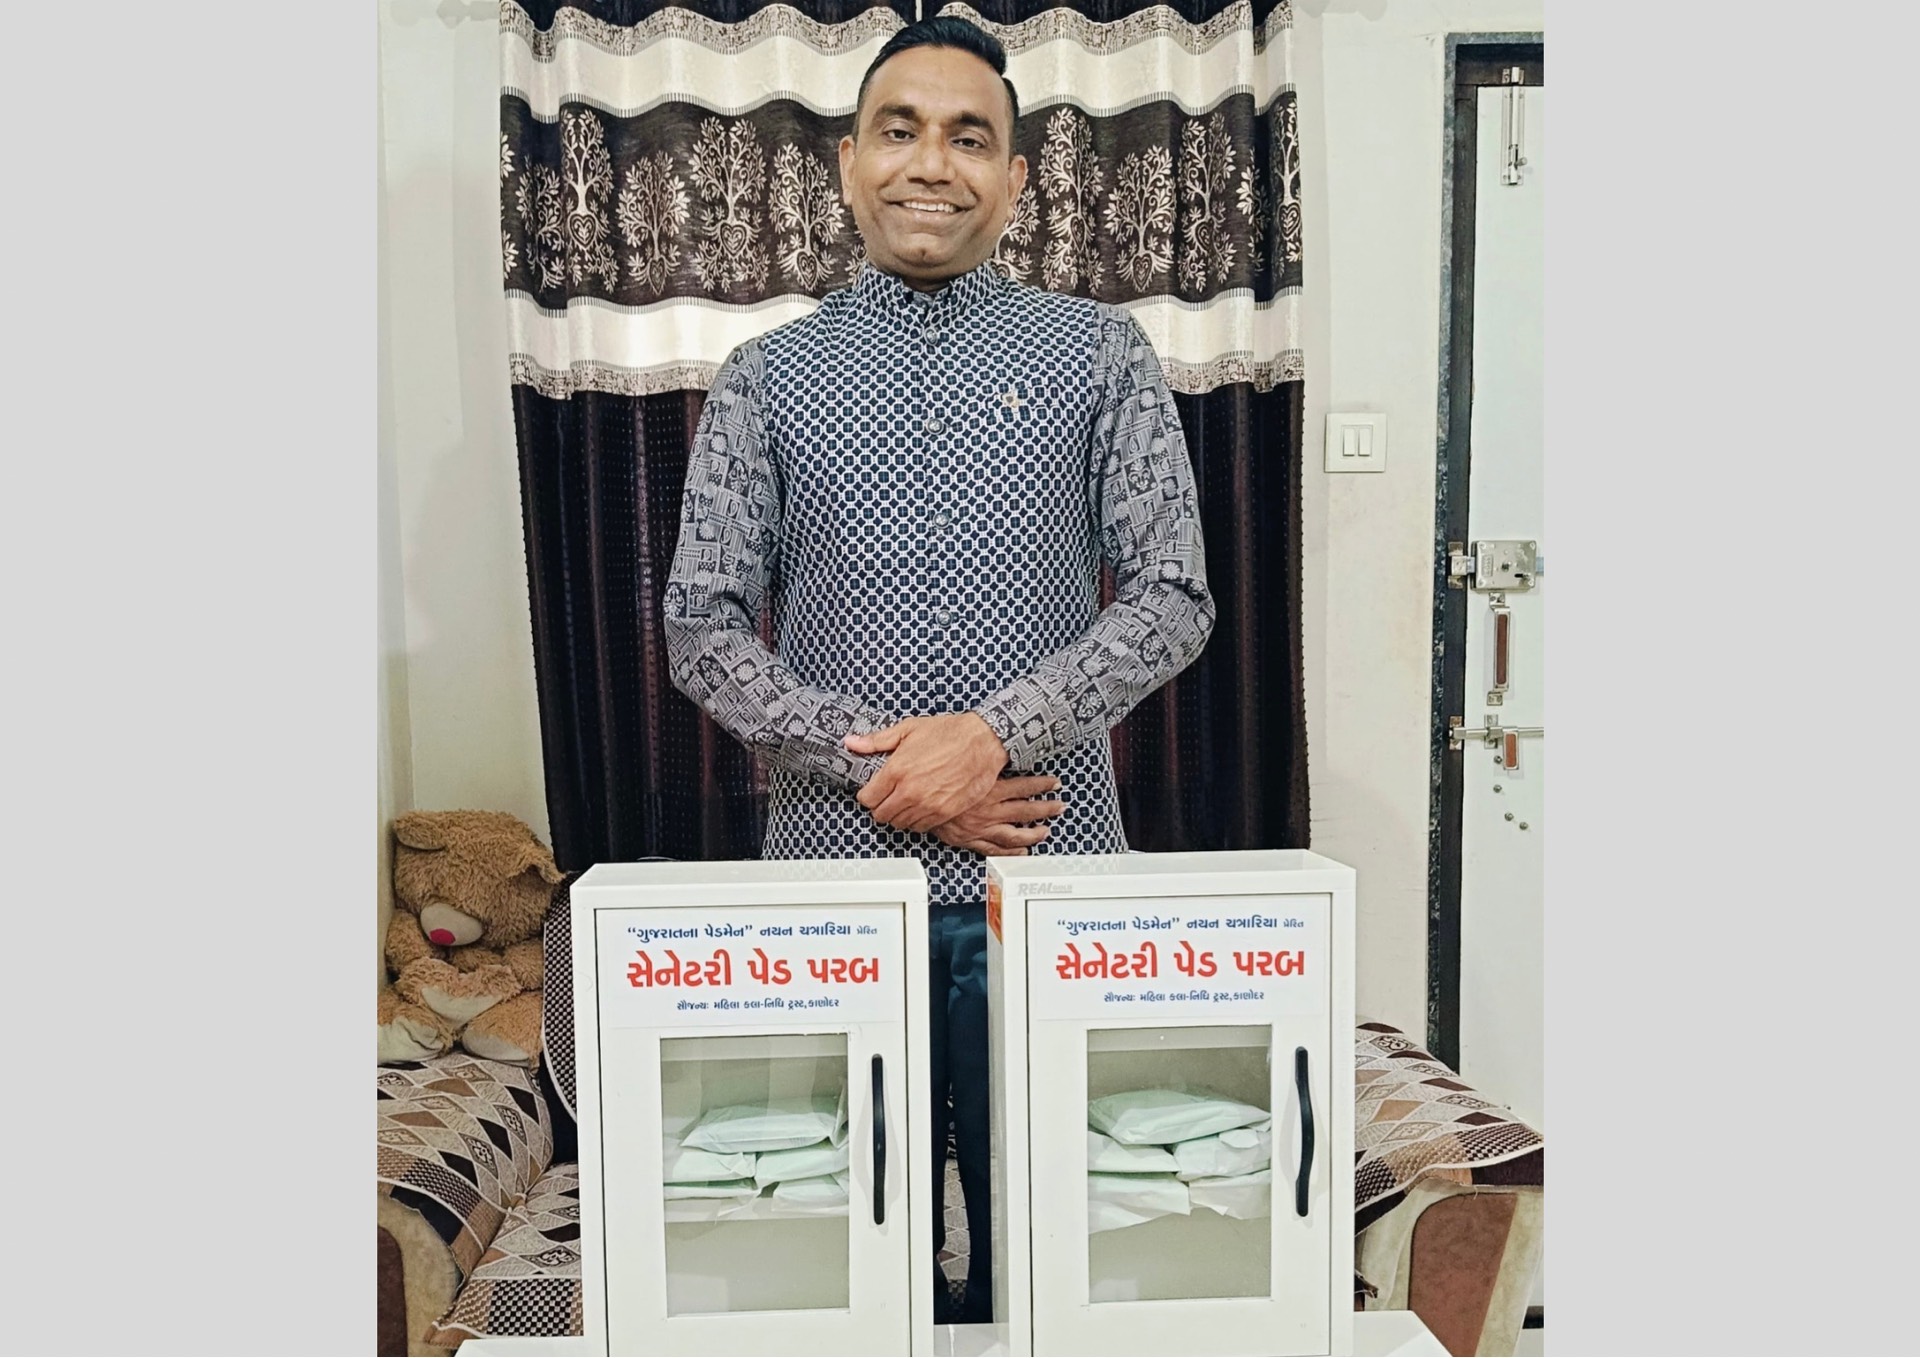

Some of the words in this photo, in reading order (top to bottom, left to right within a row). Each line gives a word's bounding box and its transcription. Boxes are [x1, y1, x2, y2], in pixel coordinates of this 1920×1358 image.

[1018, 882, 1053, 896] REAL
[1186, 918, 1220, 930] નયન
[760, 926, 793, 937] નયન
[1055, 941, 1159, 980] સેનેટરી
[1173, 940, 1218, 978] પેડ
[1233, 950, 1305, 977] પરબ
[627, 948, 732, 989] સેનેટરી
[747, 947, 793, 986] પેડ
[807, 956, 880, 985] પરબ
[1139, 990, 1166, 1003] મહિલા
[713, 998, 740, 1011] મહિલા
